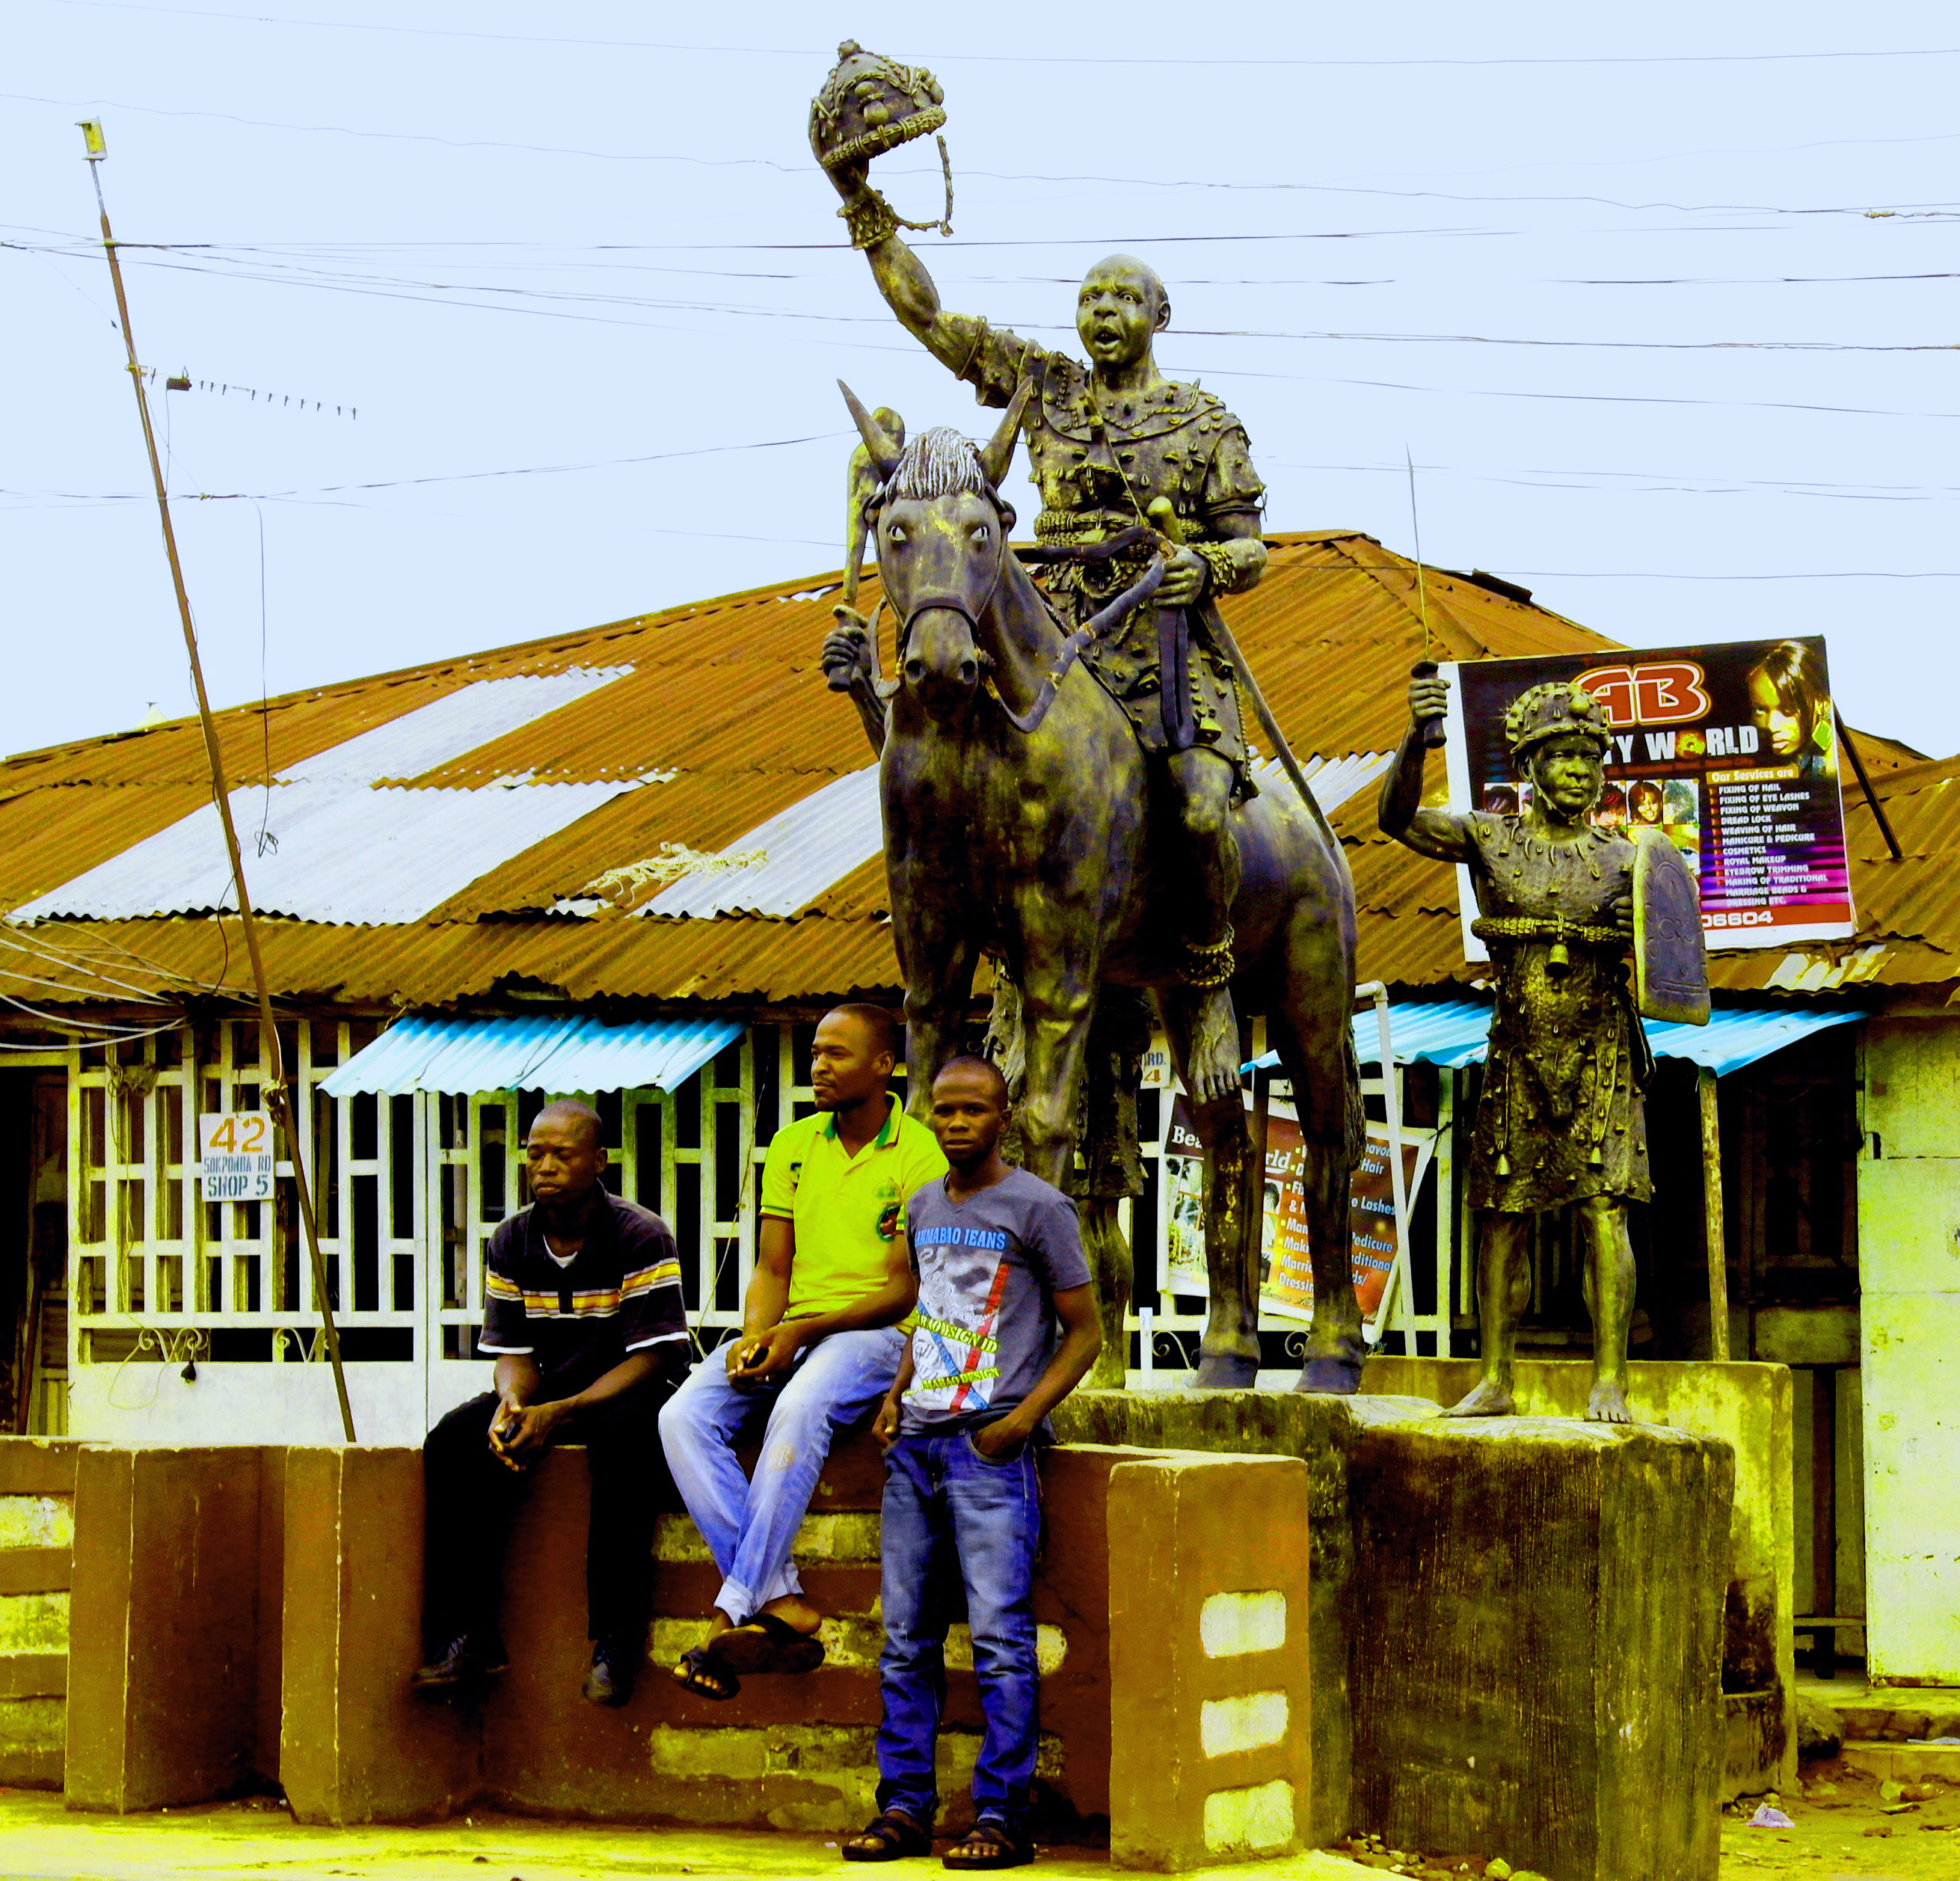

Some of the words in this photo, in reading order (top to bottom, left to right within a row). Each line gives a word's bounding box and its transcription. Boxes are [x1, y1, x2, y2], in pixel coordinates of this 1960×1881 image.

[1711, 772, 1730, 782] Our
[1733, 770, 1774, 781] Services
[1777, 769, 1793, 778] are
[1719, 785, 1746, 795] FIXING
[1748, 784, 1759, 793] OF
[1762, 783, 1781, 792] NAIL
[1720, 795, 1747, 805] FIXING
[1749, 795, 1760, 803] OF
[1762, 793, 1778, 802] EYE
[1779, 792, 1810, 802] LASHES
[1720, 805, 1748, 815] FIXING
[1749, 805, 1761, 814] OF
[1762, 803, 1799, 813] WEAVON
[1720, 816, 1749, 825] DREAD
[1751, 815, 1772, 824] LOCK
[1721, 825, 1760, 836] WEAVING
[1762, 825, 1773, 834] OF
[1775, 824, 1796, 833] HAIR
[1722, 836, 1765, 846] MANICURE
[1766, 835, 1773, 844] &
[1775, 832, 1815, 843] PEDICURE
[1723, 846, 1767, 856] COSMETICS
[1723, 857, 1751, 867] ROYAL
[1752, 855, 1786, 865] MAKEUP
[1724, 866, 1766, 877] EYEBROW
[1767, 864, 1809, 874] TRIMMING
[1725, 877, 1759, 887] MAKING
[1759, 876, 1772, 885] OF
[1773, 874, 1828, 884] TRADITIONAL
[1726, 887, 1769, 897] MARRIAGE
[1771, 885, 1798, 895] BEADS
[1801, 885, 1807, 893] &
[1726, 897, 1767, 907] DRESSING
[1144, 1069, 1161, 1083] 4
[209, 1116, 265, 1153] 42
[258, 1154, 271, 1172] RD
[1361, 1158, 1384, 1174] Hair
[208, 1175, 248, 1198] SHOP
[255, 1174, 269, 1196] 5
[1289, 1200, 1297, 1213] &
[1361, 1195, 1396, 1216] Lashes
[964, 1228, 1006, 1250] JEANS
